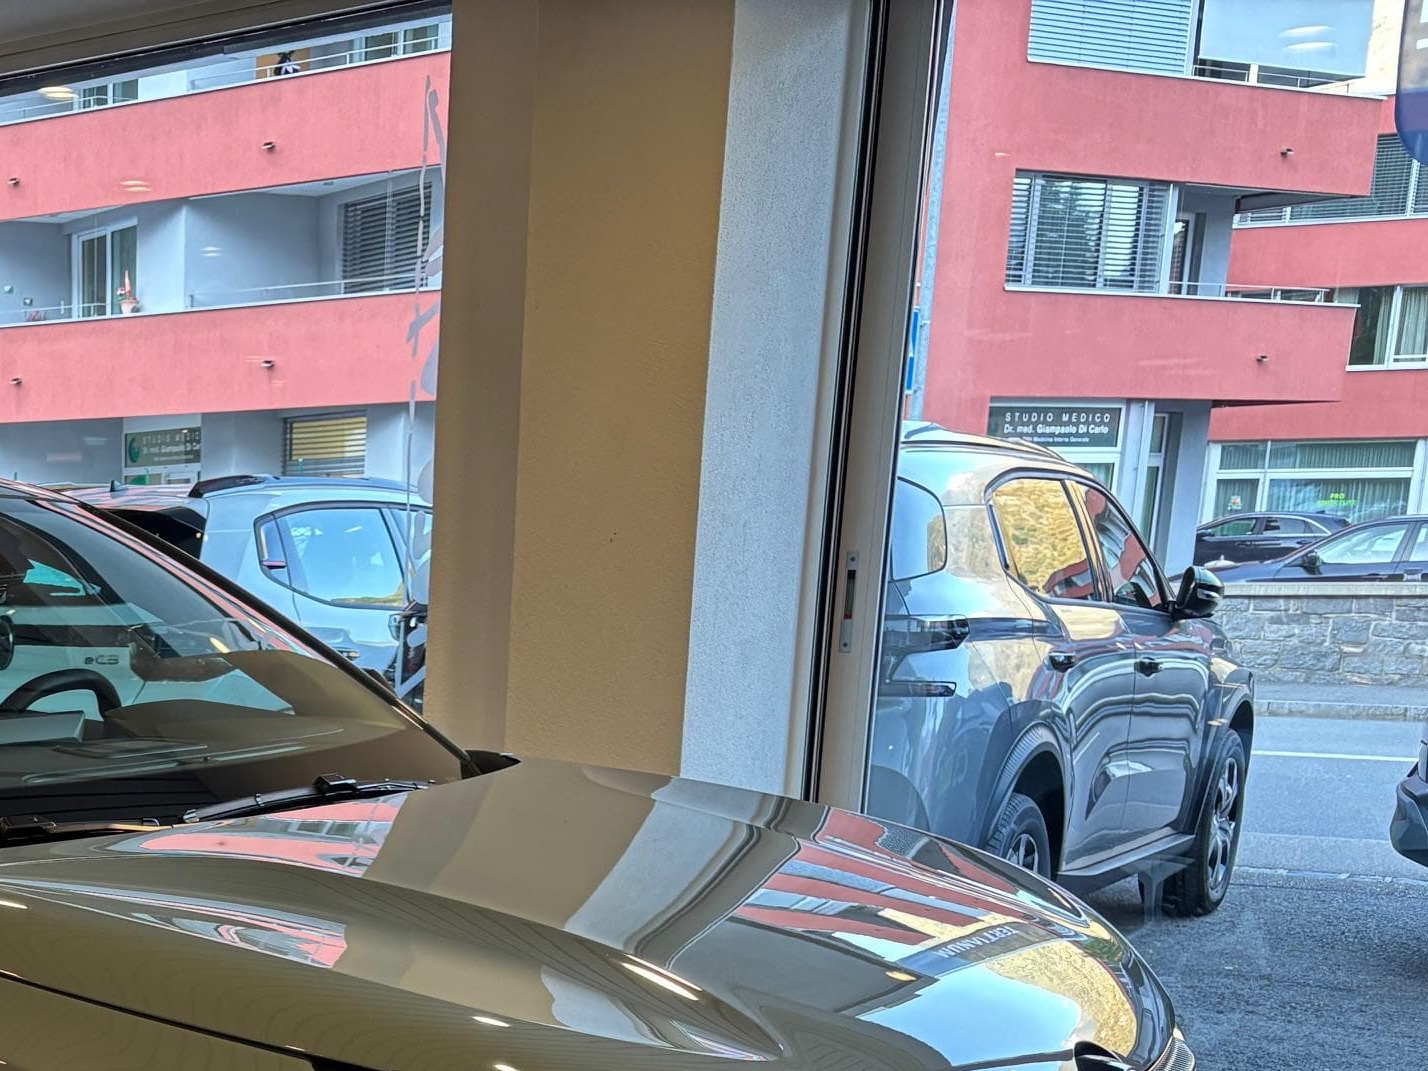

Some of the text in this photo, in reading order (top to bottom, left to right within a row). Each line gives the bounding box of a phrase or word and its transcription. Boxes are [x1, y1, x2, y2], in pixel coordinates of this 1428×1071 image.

[1005, 413, 1110, 423] STUDIO MEDICO
[1004, 424, 1015, 433] Dr.
[1017, 424, 1034, 433] med.
